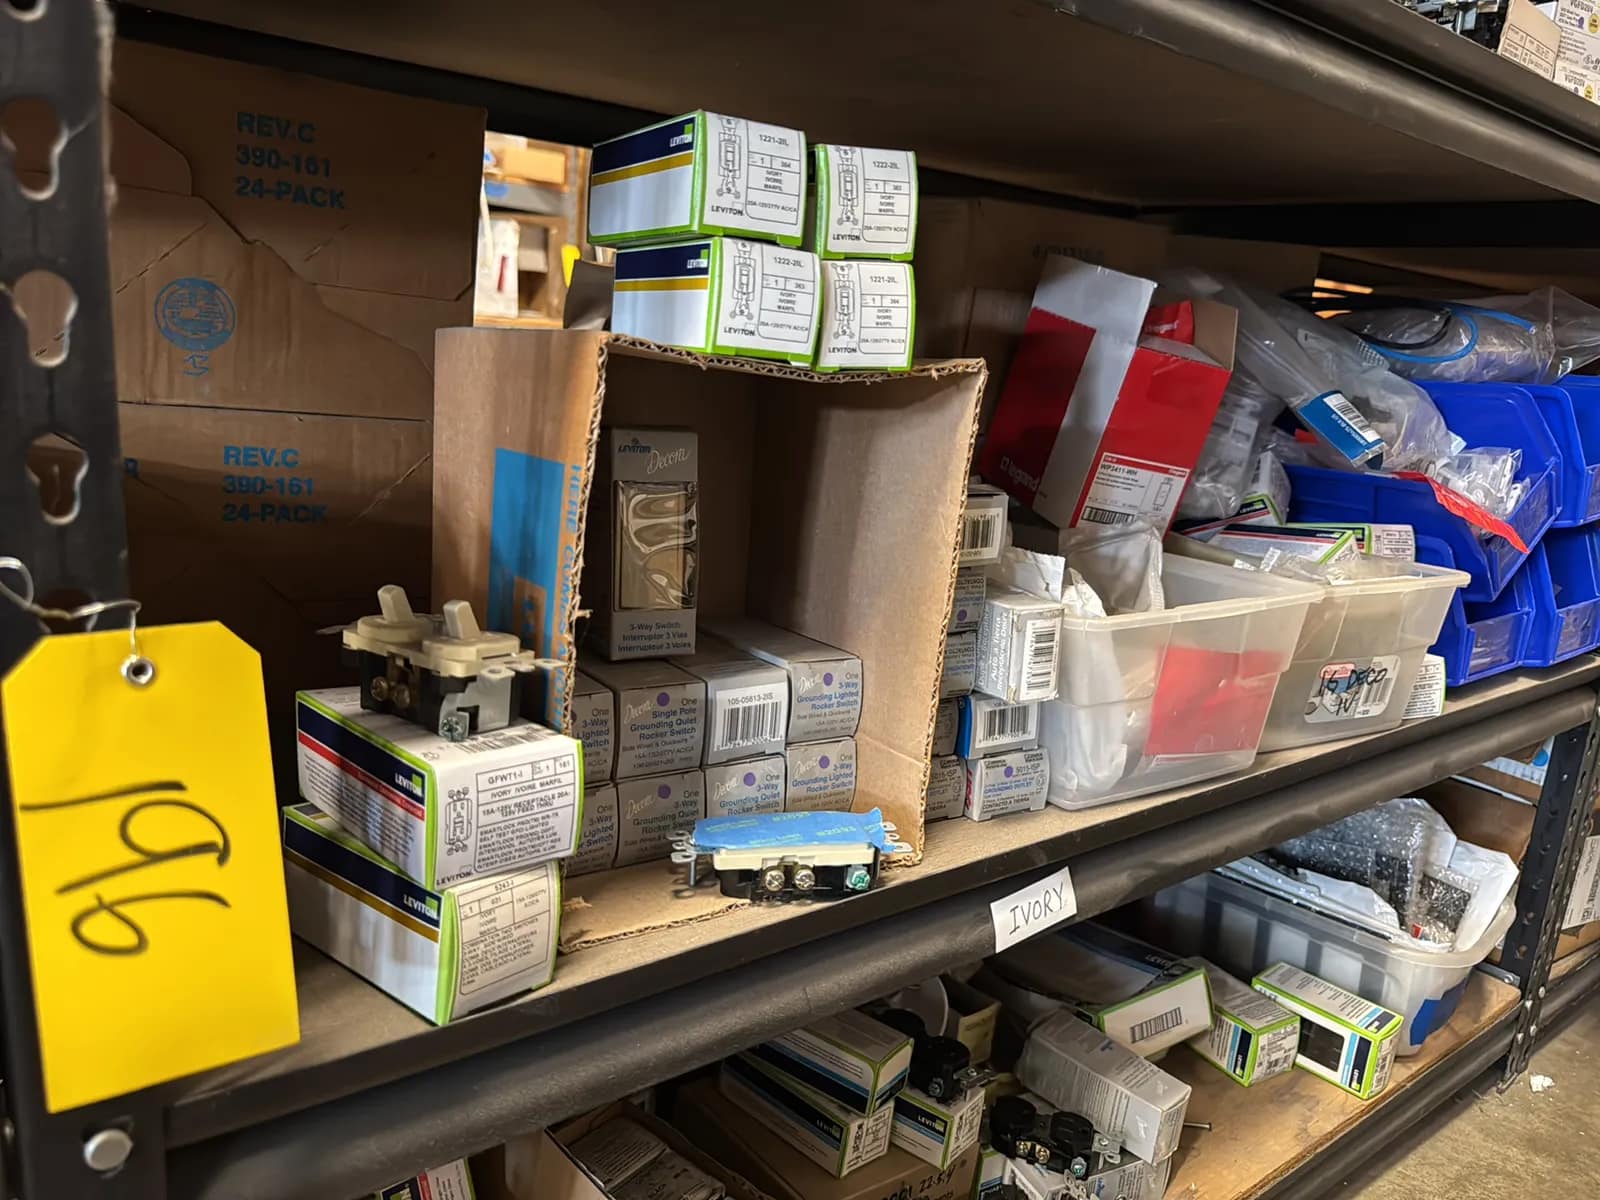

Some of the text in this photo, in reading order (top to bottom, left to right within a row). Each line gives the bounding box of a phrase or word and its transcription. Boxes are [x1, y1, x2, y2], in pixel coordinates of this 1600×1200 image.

[237, 112, 317, 145] REV.C
[235, 145, 333, 178] 390-161
[234, 176, 347, 210] 24-PACK
[711, 205, 745, 217] LEVITON
[832, 233, 861, 241] LEVITON
[723, 326, 755, 337] LEVITON
[828, 346, 857, 354] LEVITON
[223, 446, 300, 469] REV.C
[223, 475, 315, 496] 390-161
[222, 503, 327, 526] 24-PACK
[681, 698, 697, 706] One
[836, 700, 858, 708] Switch
[652, 707, 697, 720] Single Pole
[630, 720, 674, 733] Grounding
[670, 727, 697, 737] Switch
[395, 772, 422, 797] LEVITON
[766, 774, 780, 782] One
[491, 777, 563, 799] IVORY IVOIRE MARFIL
[757, 784, 779, 793] 3-Way
[720, 792, 780, 808] Grounding Quiet
[756, 802, 780, 811] Switch
[436, 870, 473, 886] LEVITON
[403, 894, 438, 920] LEVITON
[1008, 882, 1063, 935] IVORY
